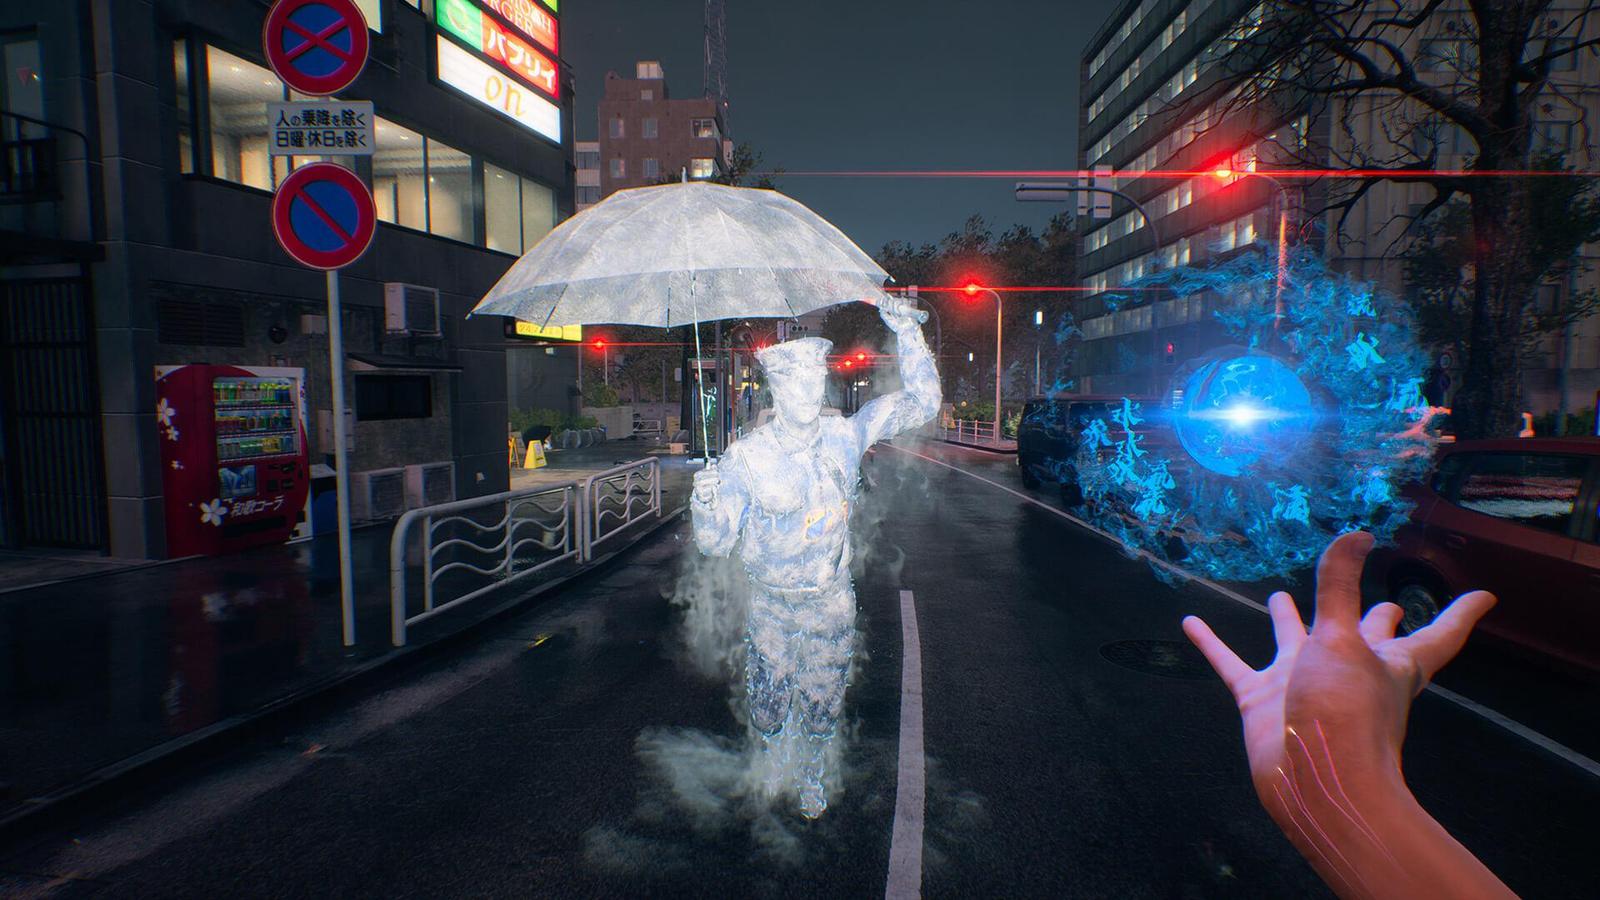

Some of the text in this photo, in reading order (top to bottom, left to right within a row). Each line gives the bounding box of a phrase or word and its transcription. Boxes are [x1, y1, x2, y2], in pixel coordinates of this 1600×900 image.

[276, 109, 366, 126] 人の乗降を除く
